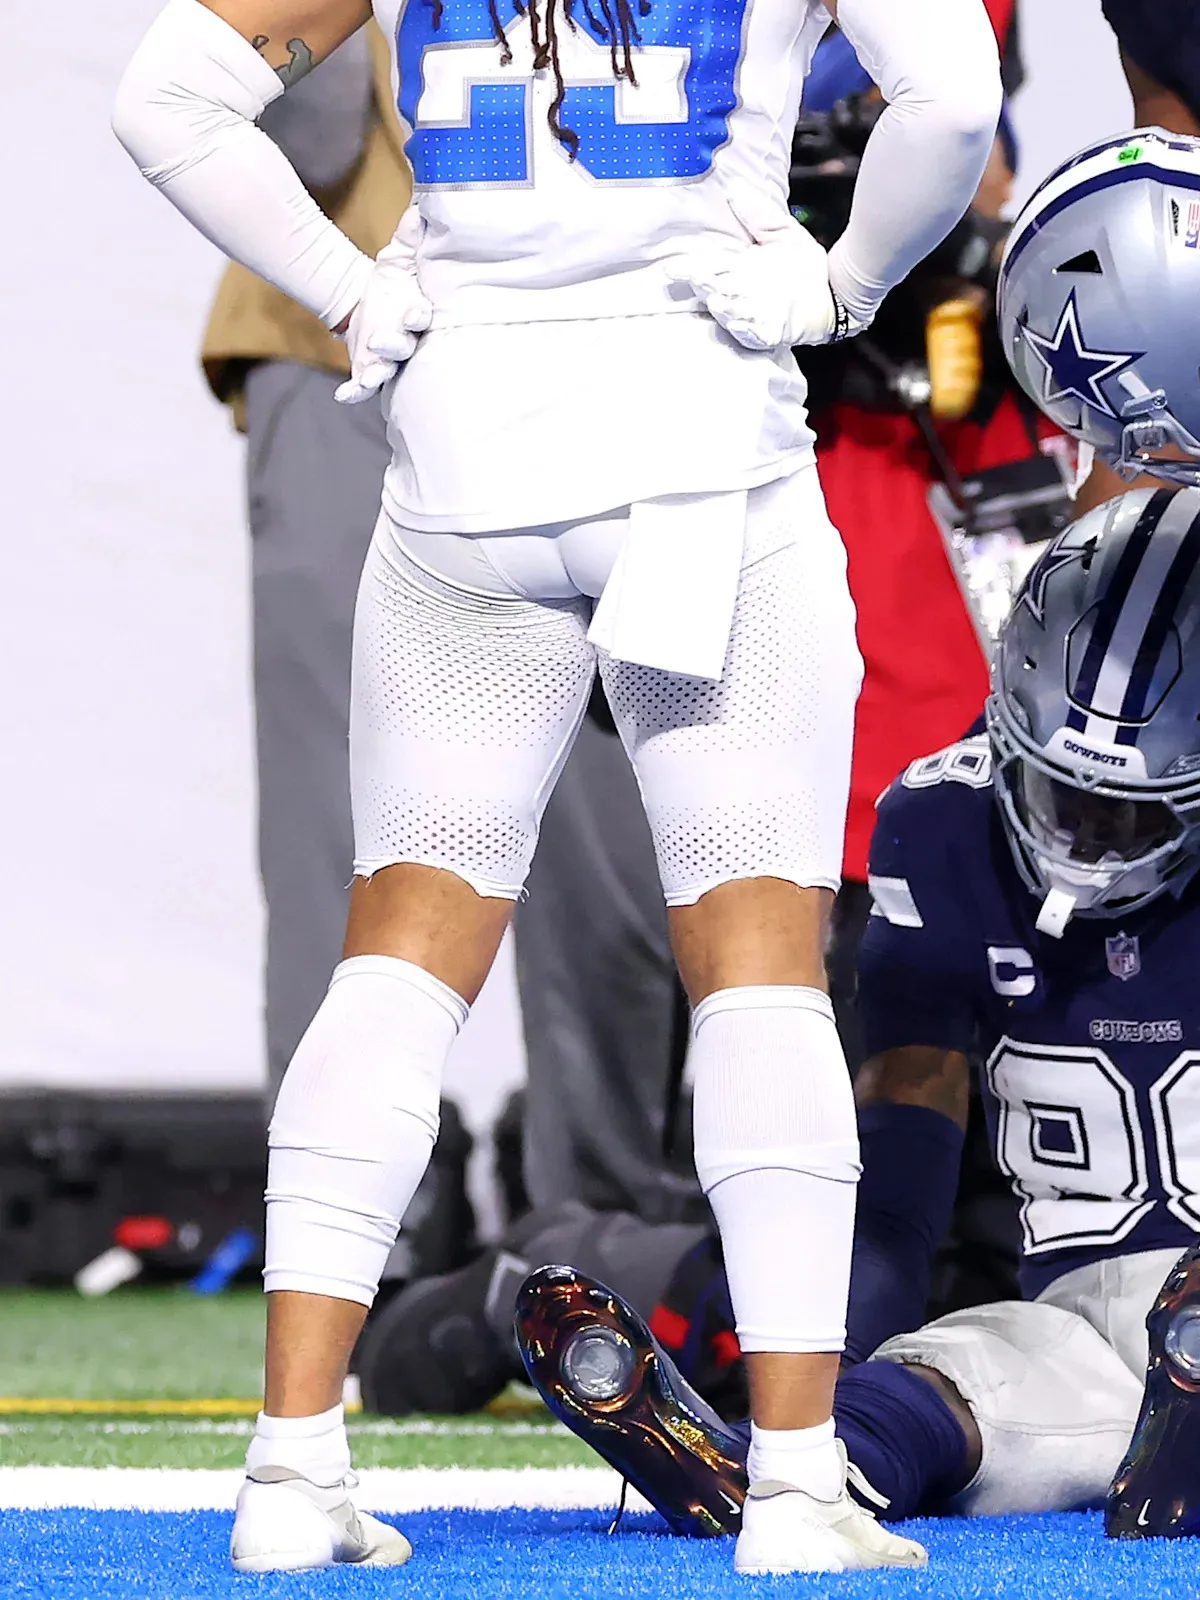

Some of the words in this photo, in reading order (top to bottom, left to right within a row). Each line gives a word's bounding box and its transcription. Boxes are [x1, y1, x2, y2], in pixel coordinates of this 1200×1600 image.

[1063, 739, 1129, 767] COWBOYS
[987, 945, 1036, 996] C
[1089, 1019, 1184, 1043] COWBOYS
